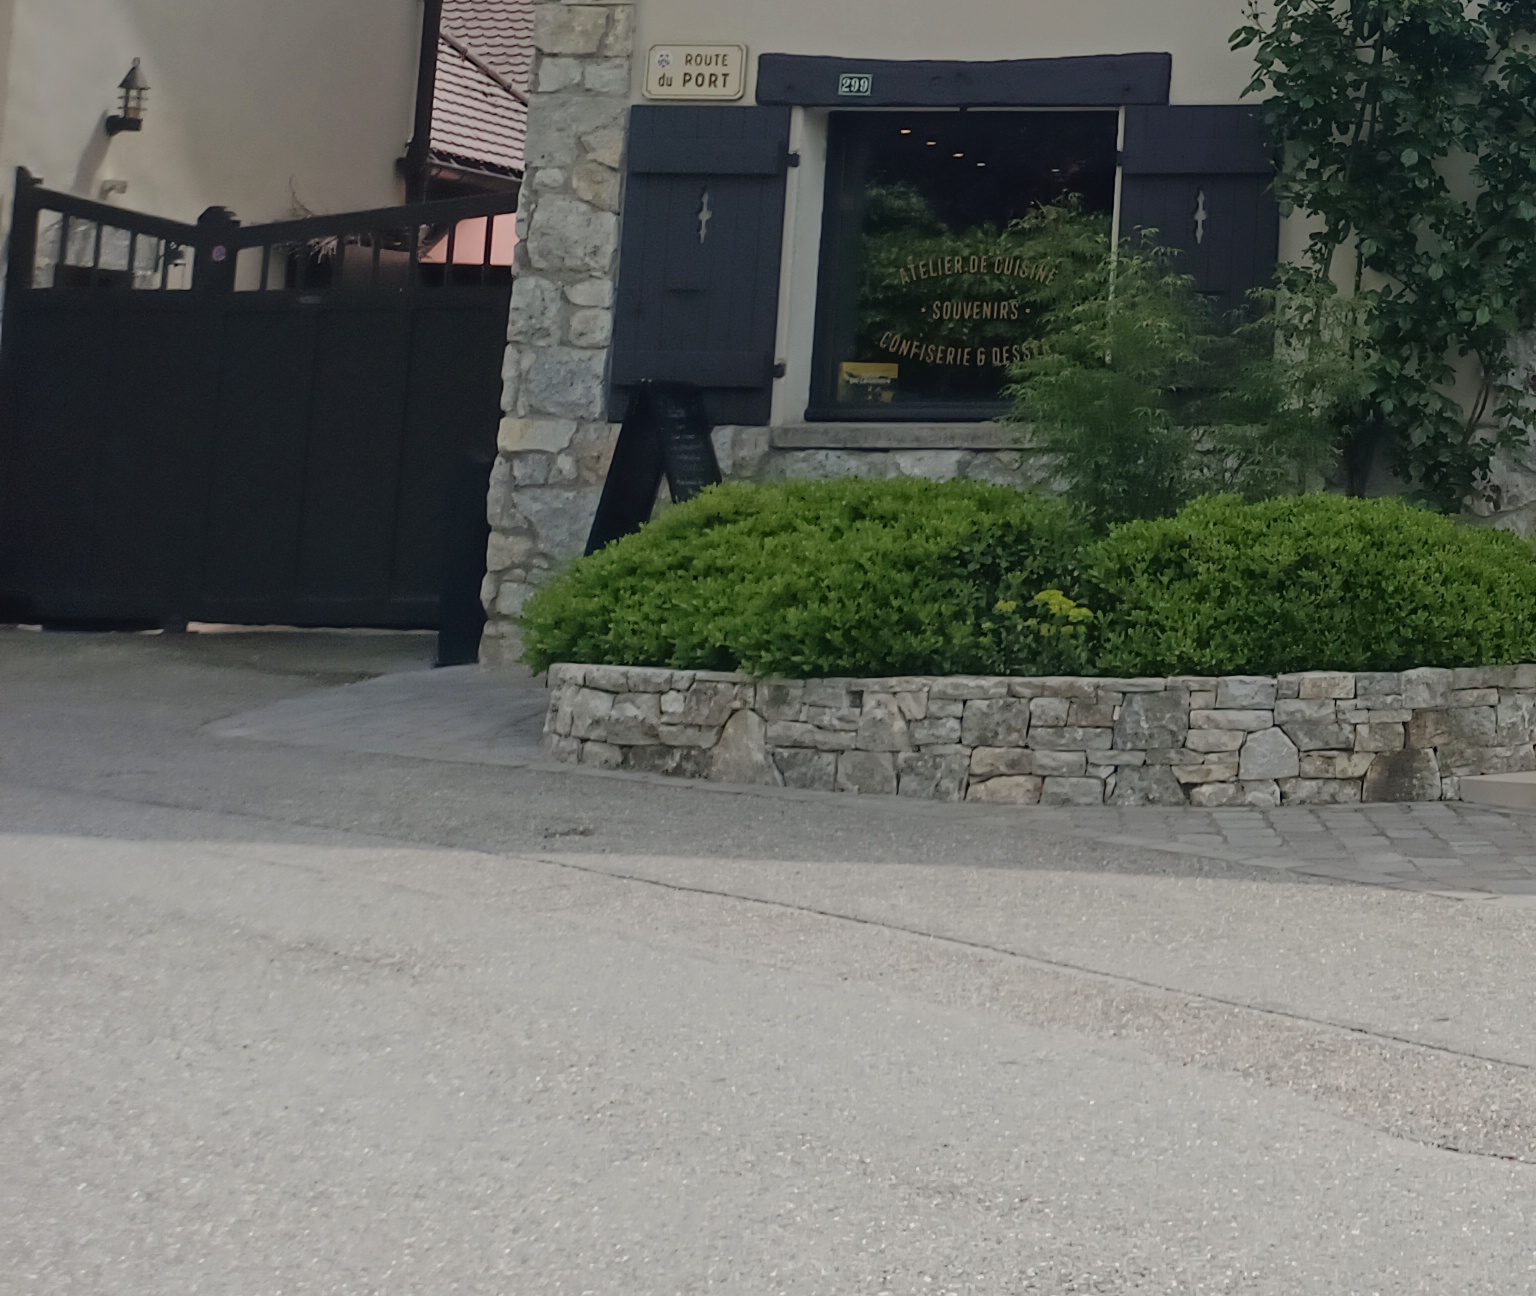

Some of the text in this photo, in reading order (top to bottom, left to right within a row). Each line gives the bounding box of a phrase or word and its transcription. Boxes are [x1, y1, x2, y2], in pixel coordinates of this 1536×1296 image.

[684, 53, 729, 67] ROUTE
[657, 72, 730, 88] du PORT
[840, 76, 870, 94] 299
[900, 255, 1059, 286] ATELIER DE CUISINE
[932, 300, 1019, 320] SOUVENIRS
[879, 330, 972, 366] CONFISERIE
